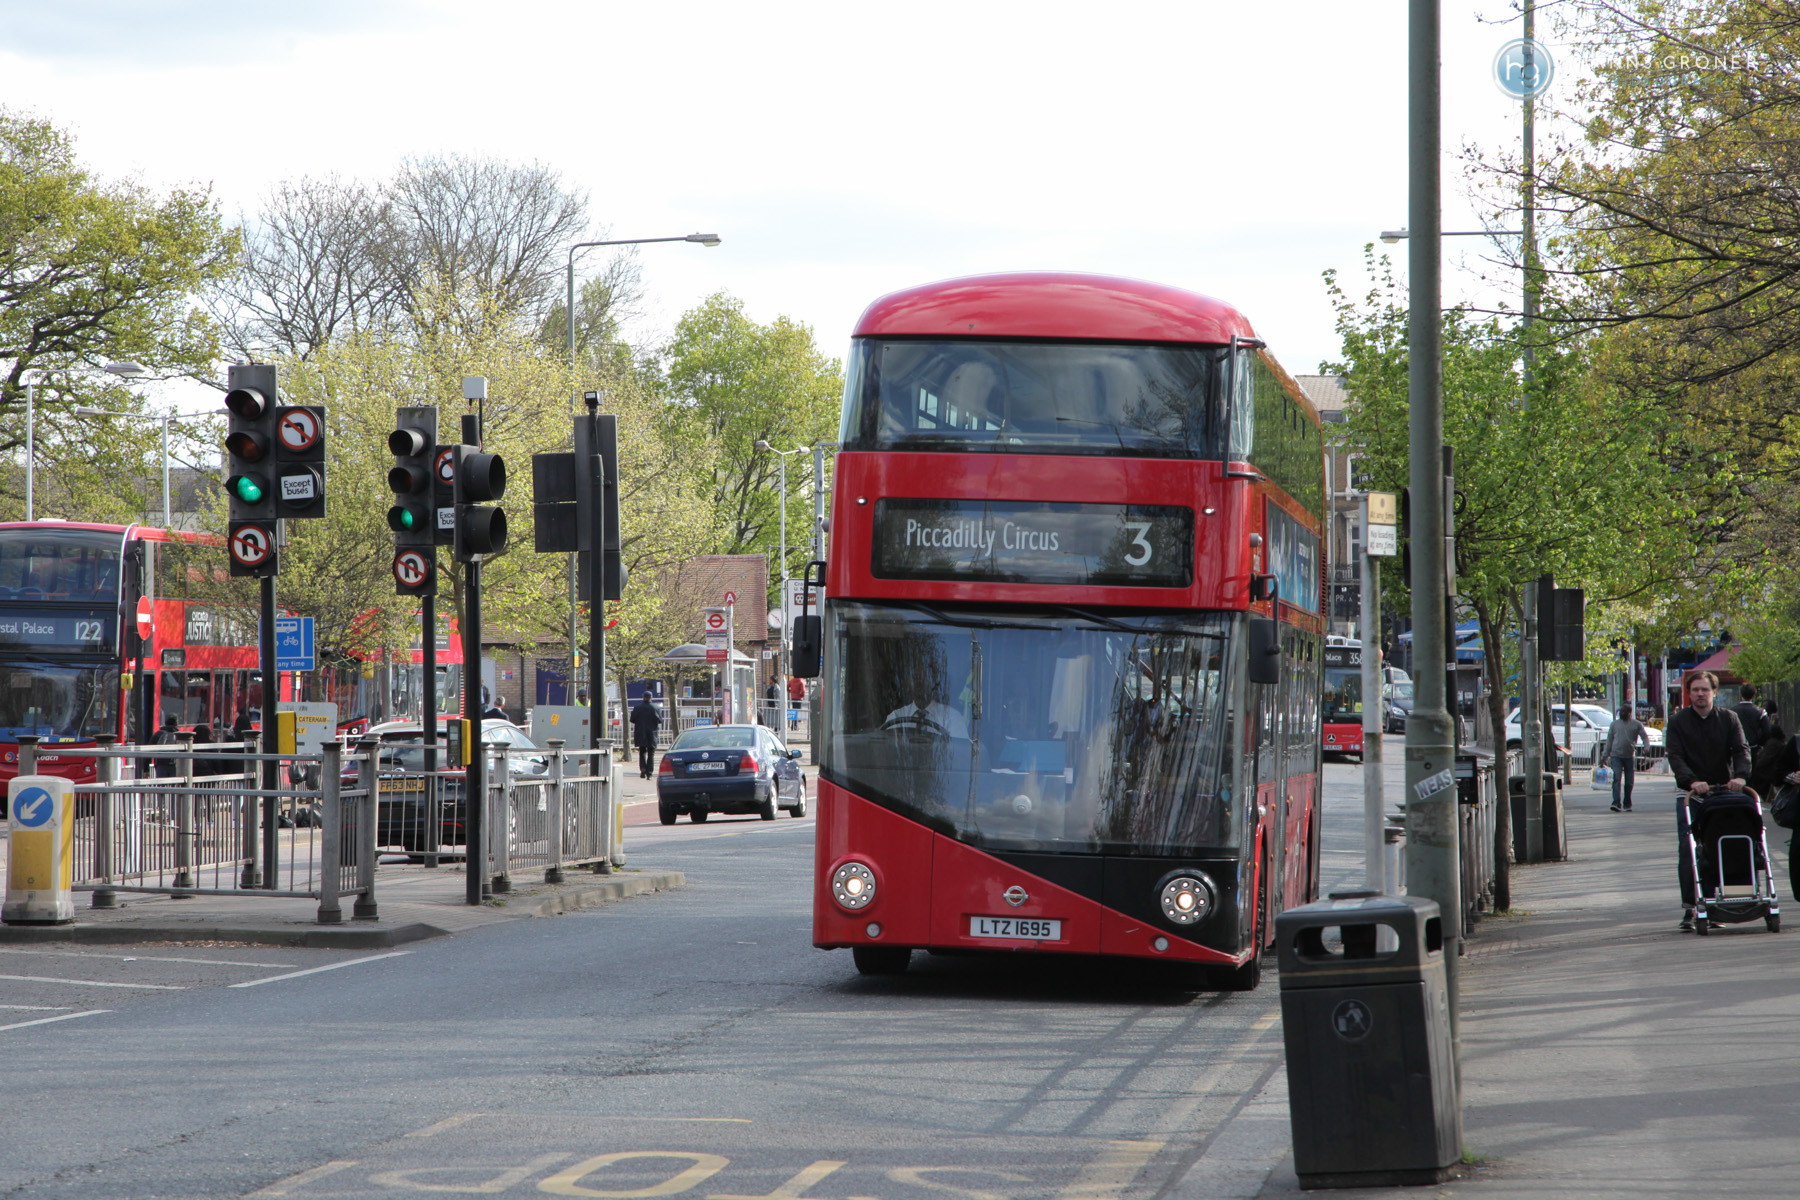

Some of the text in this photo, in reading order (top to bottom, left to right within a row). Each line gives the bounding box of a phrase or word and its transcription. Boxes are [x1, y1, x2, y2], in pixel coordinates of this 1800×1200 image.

[283, 479, 311, 488] Except
[286, 486, 309, 495] buses
[439, 511, 455, 519] Exce
[1385, 511, 1395, 520] time
[906, 519, 1059, 557] Piccadilly Circus
[1123, 522, 1153, 566] 3
[726, 593, 735, 602] A
[22, 621, 54, 634] Palace
[75, 621, 102, 641] 122
[405, 780, 424, 790] NHJ
[980, 919, 1051, 937] LTZ 1695
